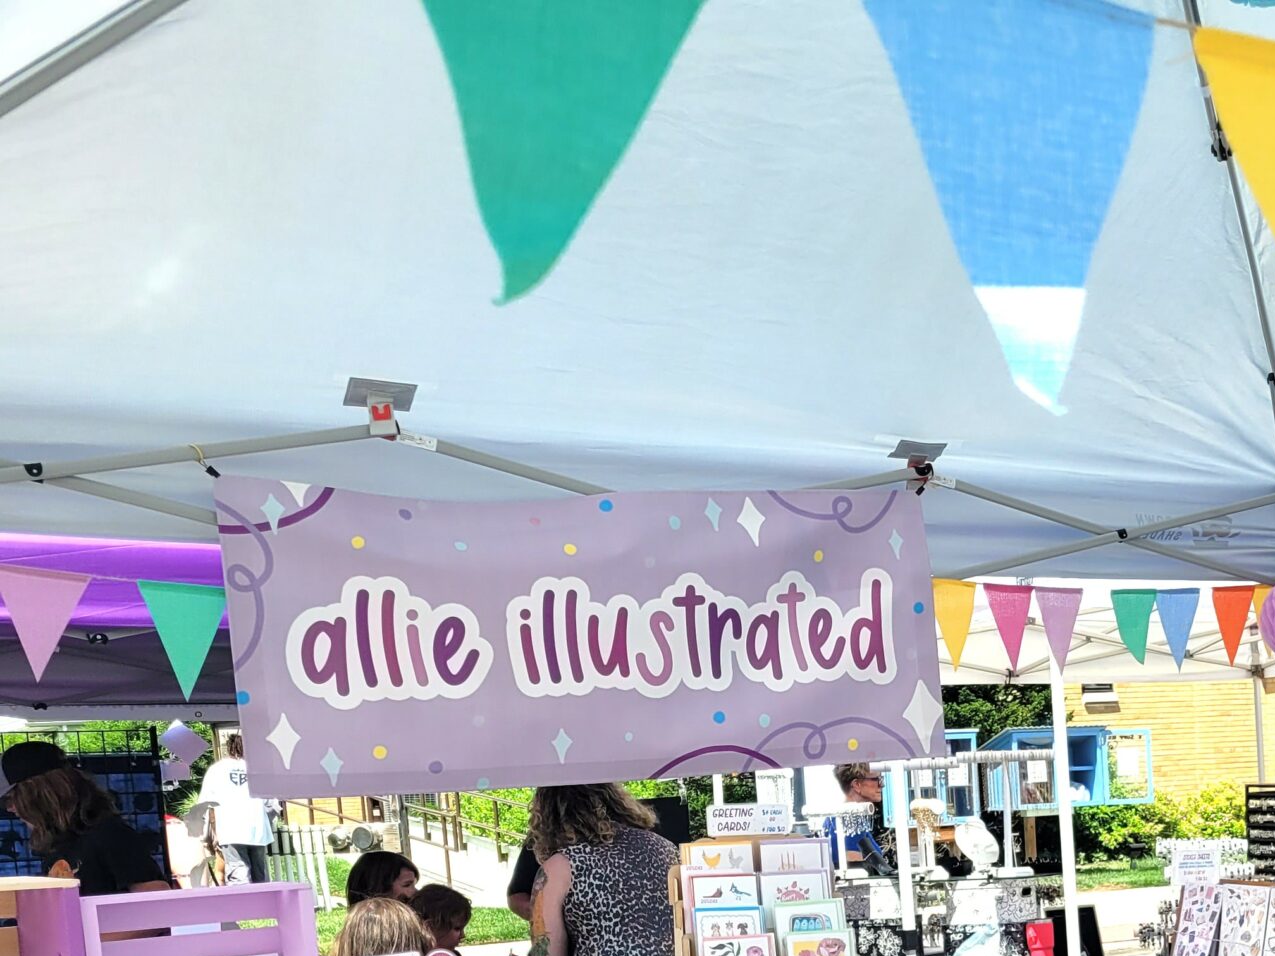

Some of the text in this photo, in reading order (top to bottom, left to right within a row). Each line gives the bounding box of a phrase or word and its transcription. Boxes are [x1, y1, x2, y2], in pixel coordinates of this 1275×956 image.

[300, 578, 888, 697] allie illustrated
[712, 808, 754, 818] GREETING
[717, 821, 751, 832] CARDS!
